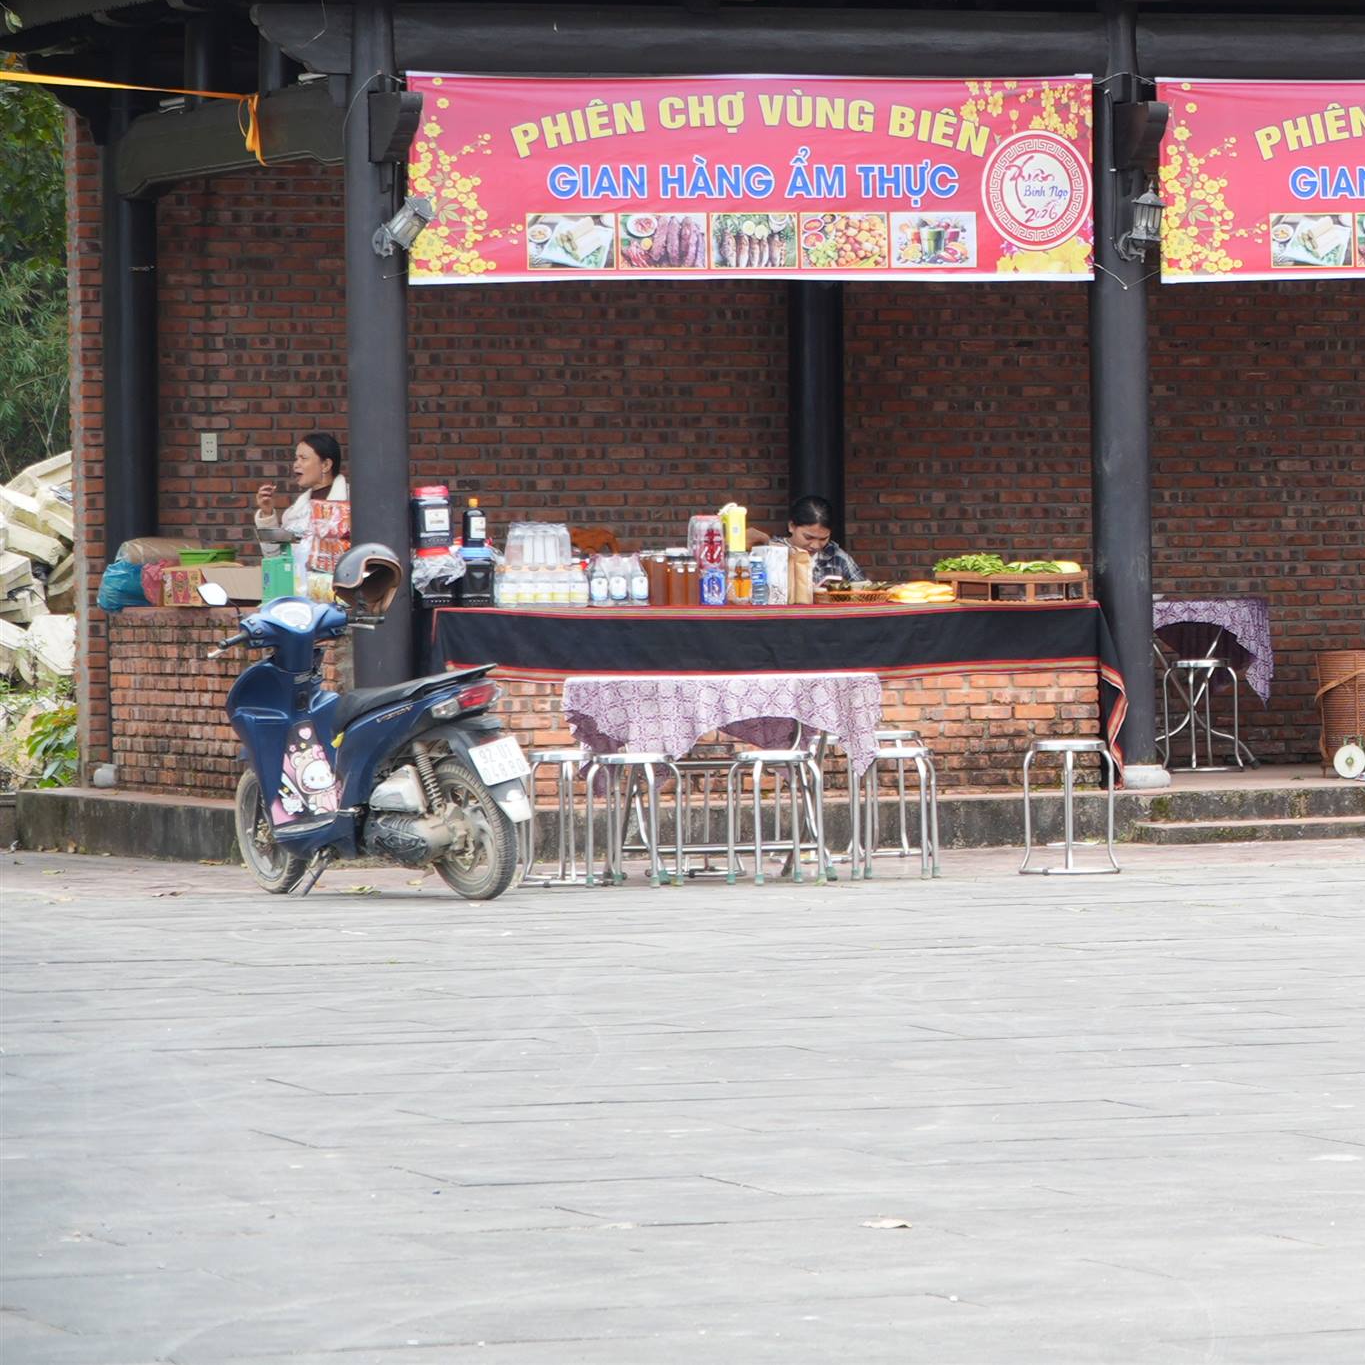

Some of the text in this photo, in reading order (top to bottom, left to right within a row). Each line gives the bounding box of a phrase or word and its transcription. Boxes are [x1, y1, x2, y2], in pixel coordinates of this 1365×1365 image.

[511, 88, 990, 158] PHIÊN CHỢ VÙNG BIÊN
[548, 145, 960, 208] GIAN HÀNG ẨM THỰC
[1024, 201, 1058, 223] 2026
